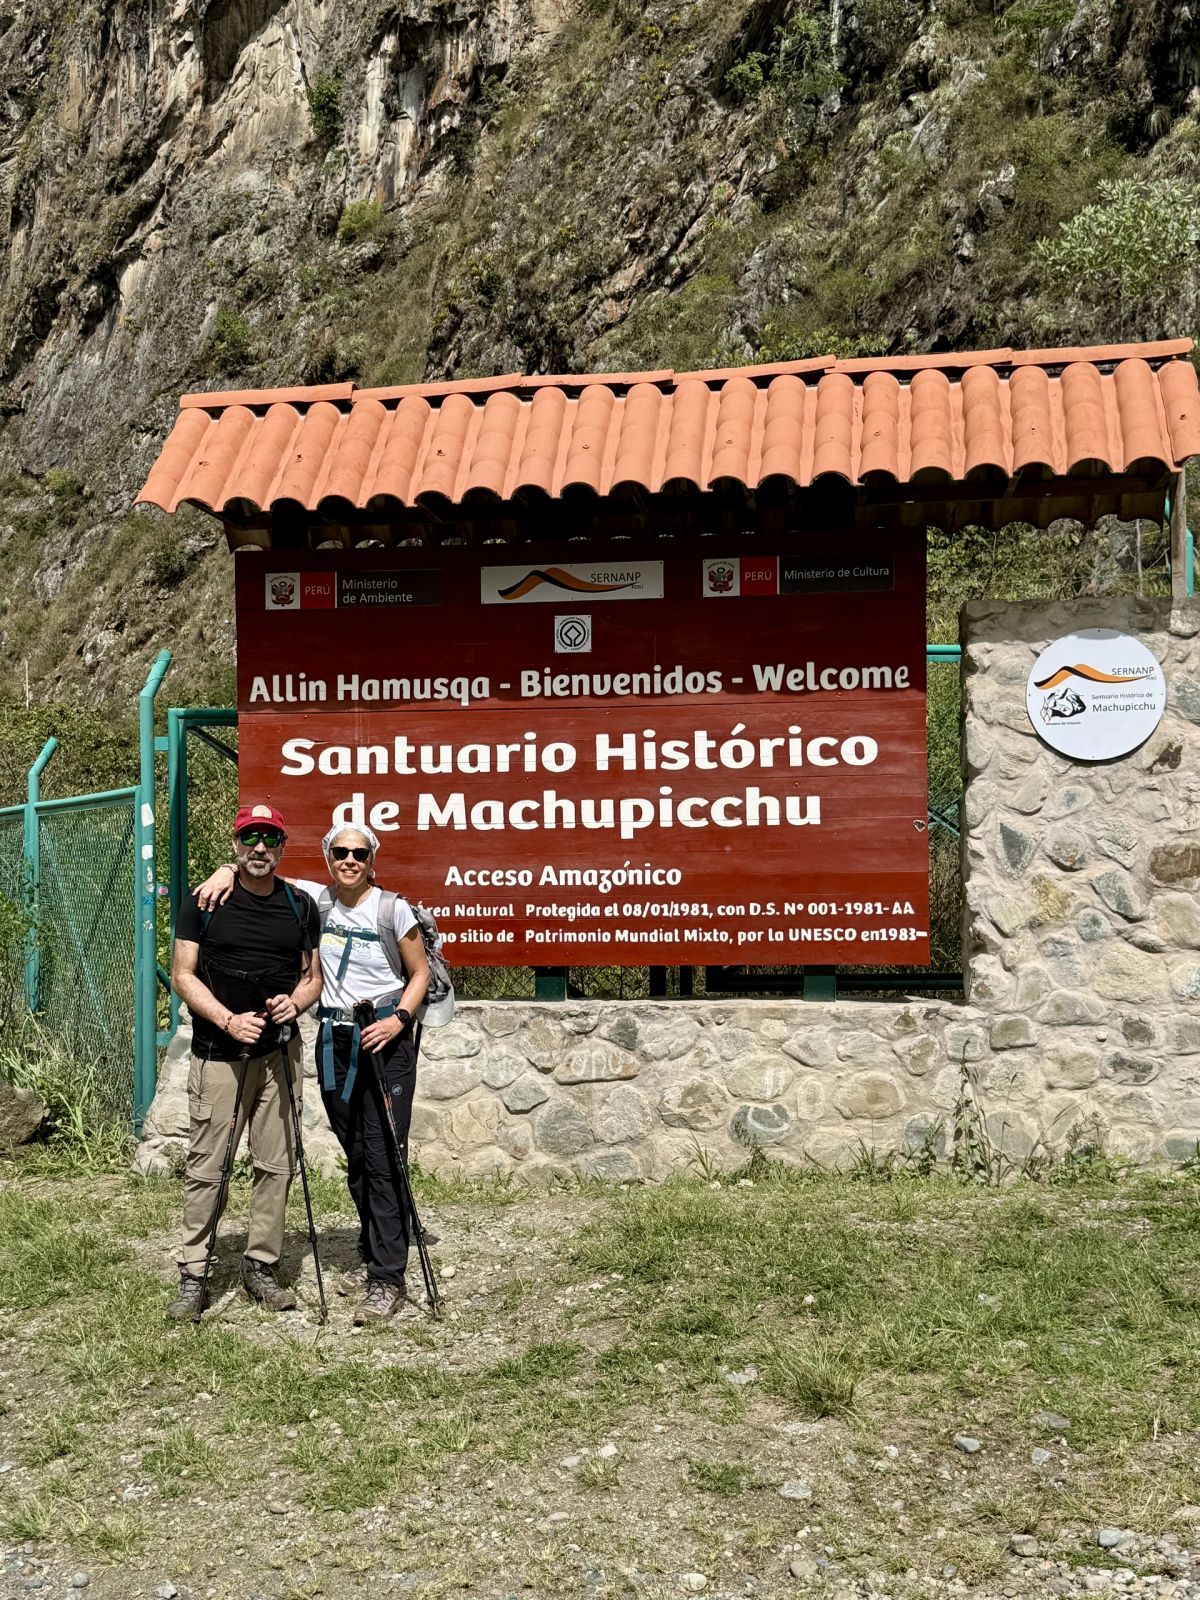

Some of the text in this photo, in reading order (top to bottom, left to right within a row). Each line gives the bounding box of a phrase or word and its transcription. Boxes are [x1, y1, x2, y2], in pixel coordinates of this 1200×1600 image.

[590, 571, 641, 583] SERNANP
[744, 570, 772, 581] PERÚ
[784, 566, 889, 580] Ministerio de Cultura
[305, 584, 330, 595] PERÚ
[342, 579, 398, 590] Ministerio
[342, 592, 413, 604] de Ambiente
[1111, 667, 1154, 676] SERNANP
[250, 672, 327, 702] Allin
[337, 674, 490, 706] Hamusqa
[520, 665, 723, 697] Bienvenidos
[752, 661, 910, 692] Welcome
[1092, 702, 1156, 713] Machupicchu
[280, 722, 879, 776] Santuario Histórico
[332, 785, 821, 839] de Machupicchu
[444, 860, 682, 894] Acceso Amazónico
[454, 903, 515, 917] Natural
[525, 903, 601, 922] Protegida
[604, 902, 619, 917] el
[622, 901, 714, 919] 08/01/1981,
[716, 905, 746, 916] con
[749, 902, 780, 916] D.S.
[460, 929, 493, 943] sitio
[496, 929, 515, 943] de
[525, 928, 611, 943] Patrimonio
[614, 928, 680, 943] Mundial
[684, 927, 734, 945] Mixto,
[737, 931, 765, 946] por
[768, 927, 784, 942] la
[788, 927, 857, 942] UNESCO
